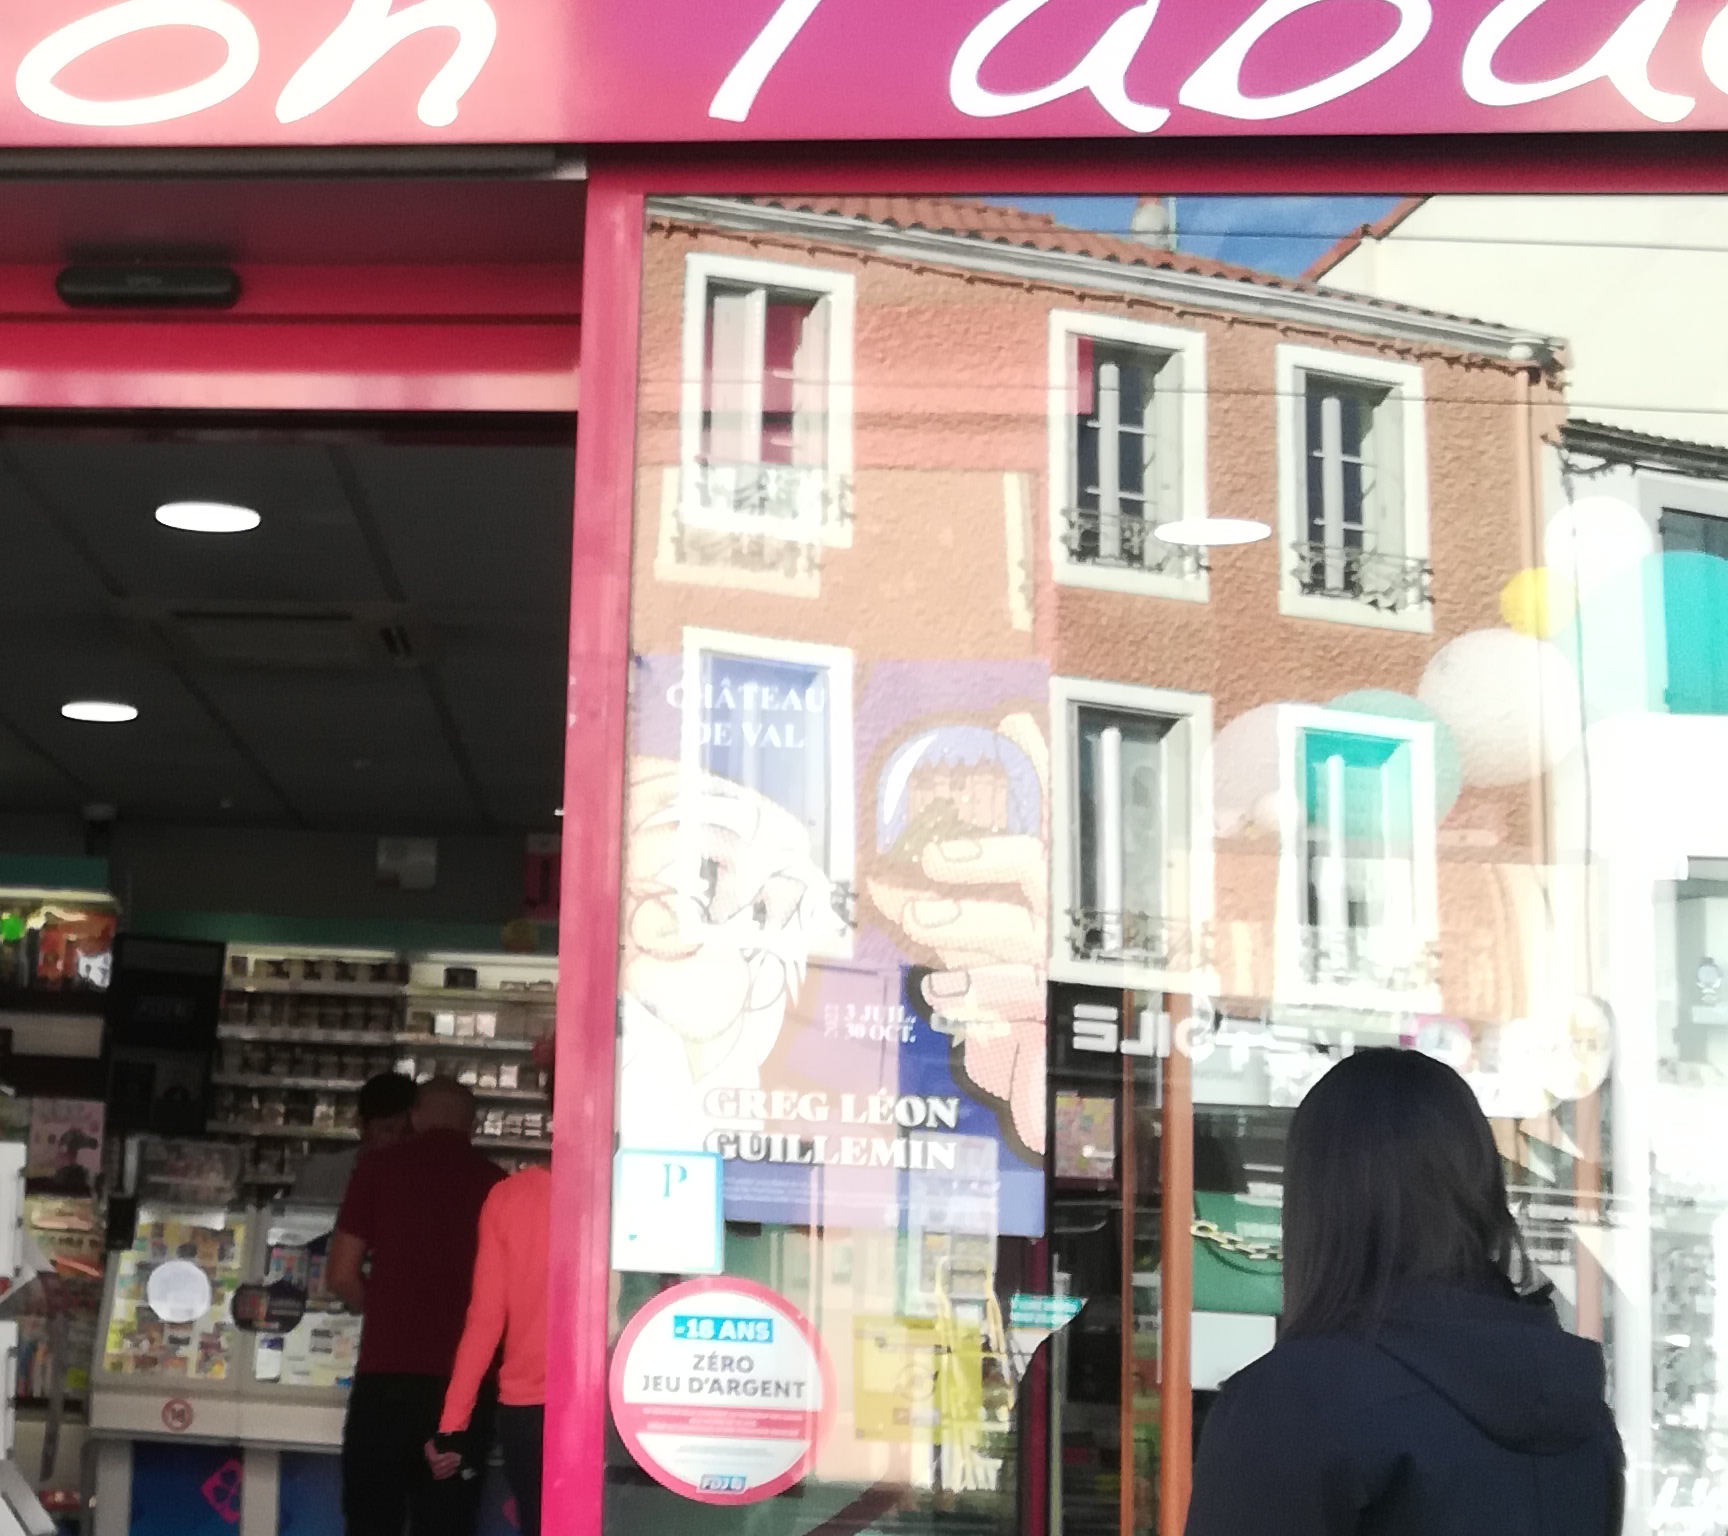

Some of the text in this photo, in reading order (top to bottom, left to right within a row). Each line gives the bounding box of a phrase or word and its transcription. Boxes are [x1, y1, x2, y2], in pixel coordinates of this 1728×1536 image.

[741, 720, 806, 749] VAL
[703, 1087, 961, 1130] GREG LÉON
[703, 1131, 958, 1171] GUILLEMIN
[675, 1318, 771, 1341] -18 ANS
[692, 1350, 755, 1374] ZÉRO
[642, 1374, 806, 1399] JEU D'ARGENT
